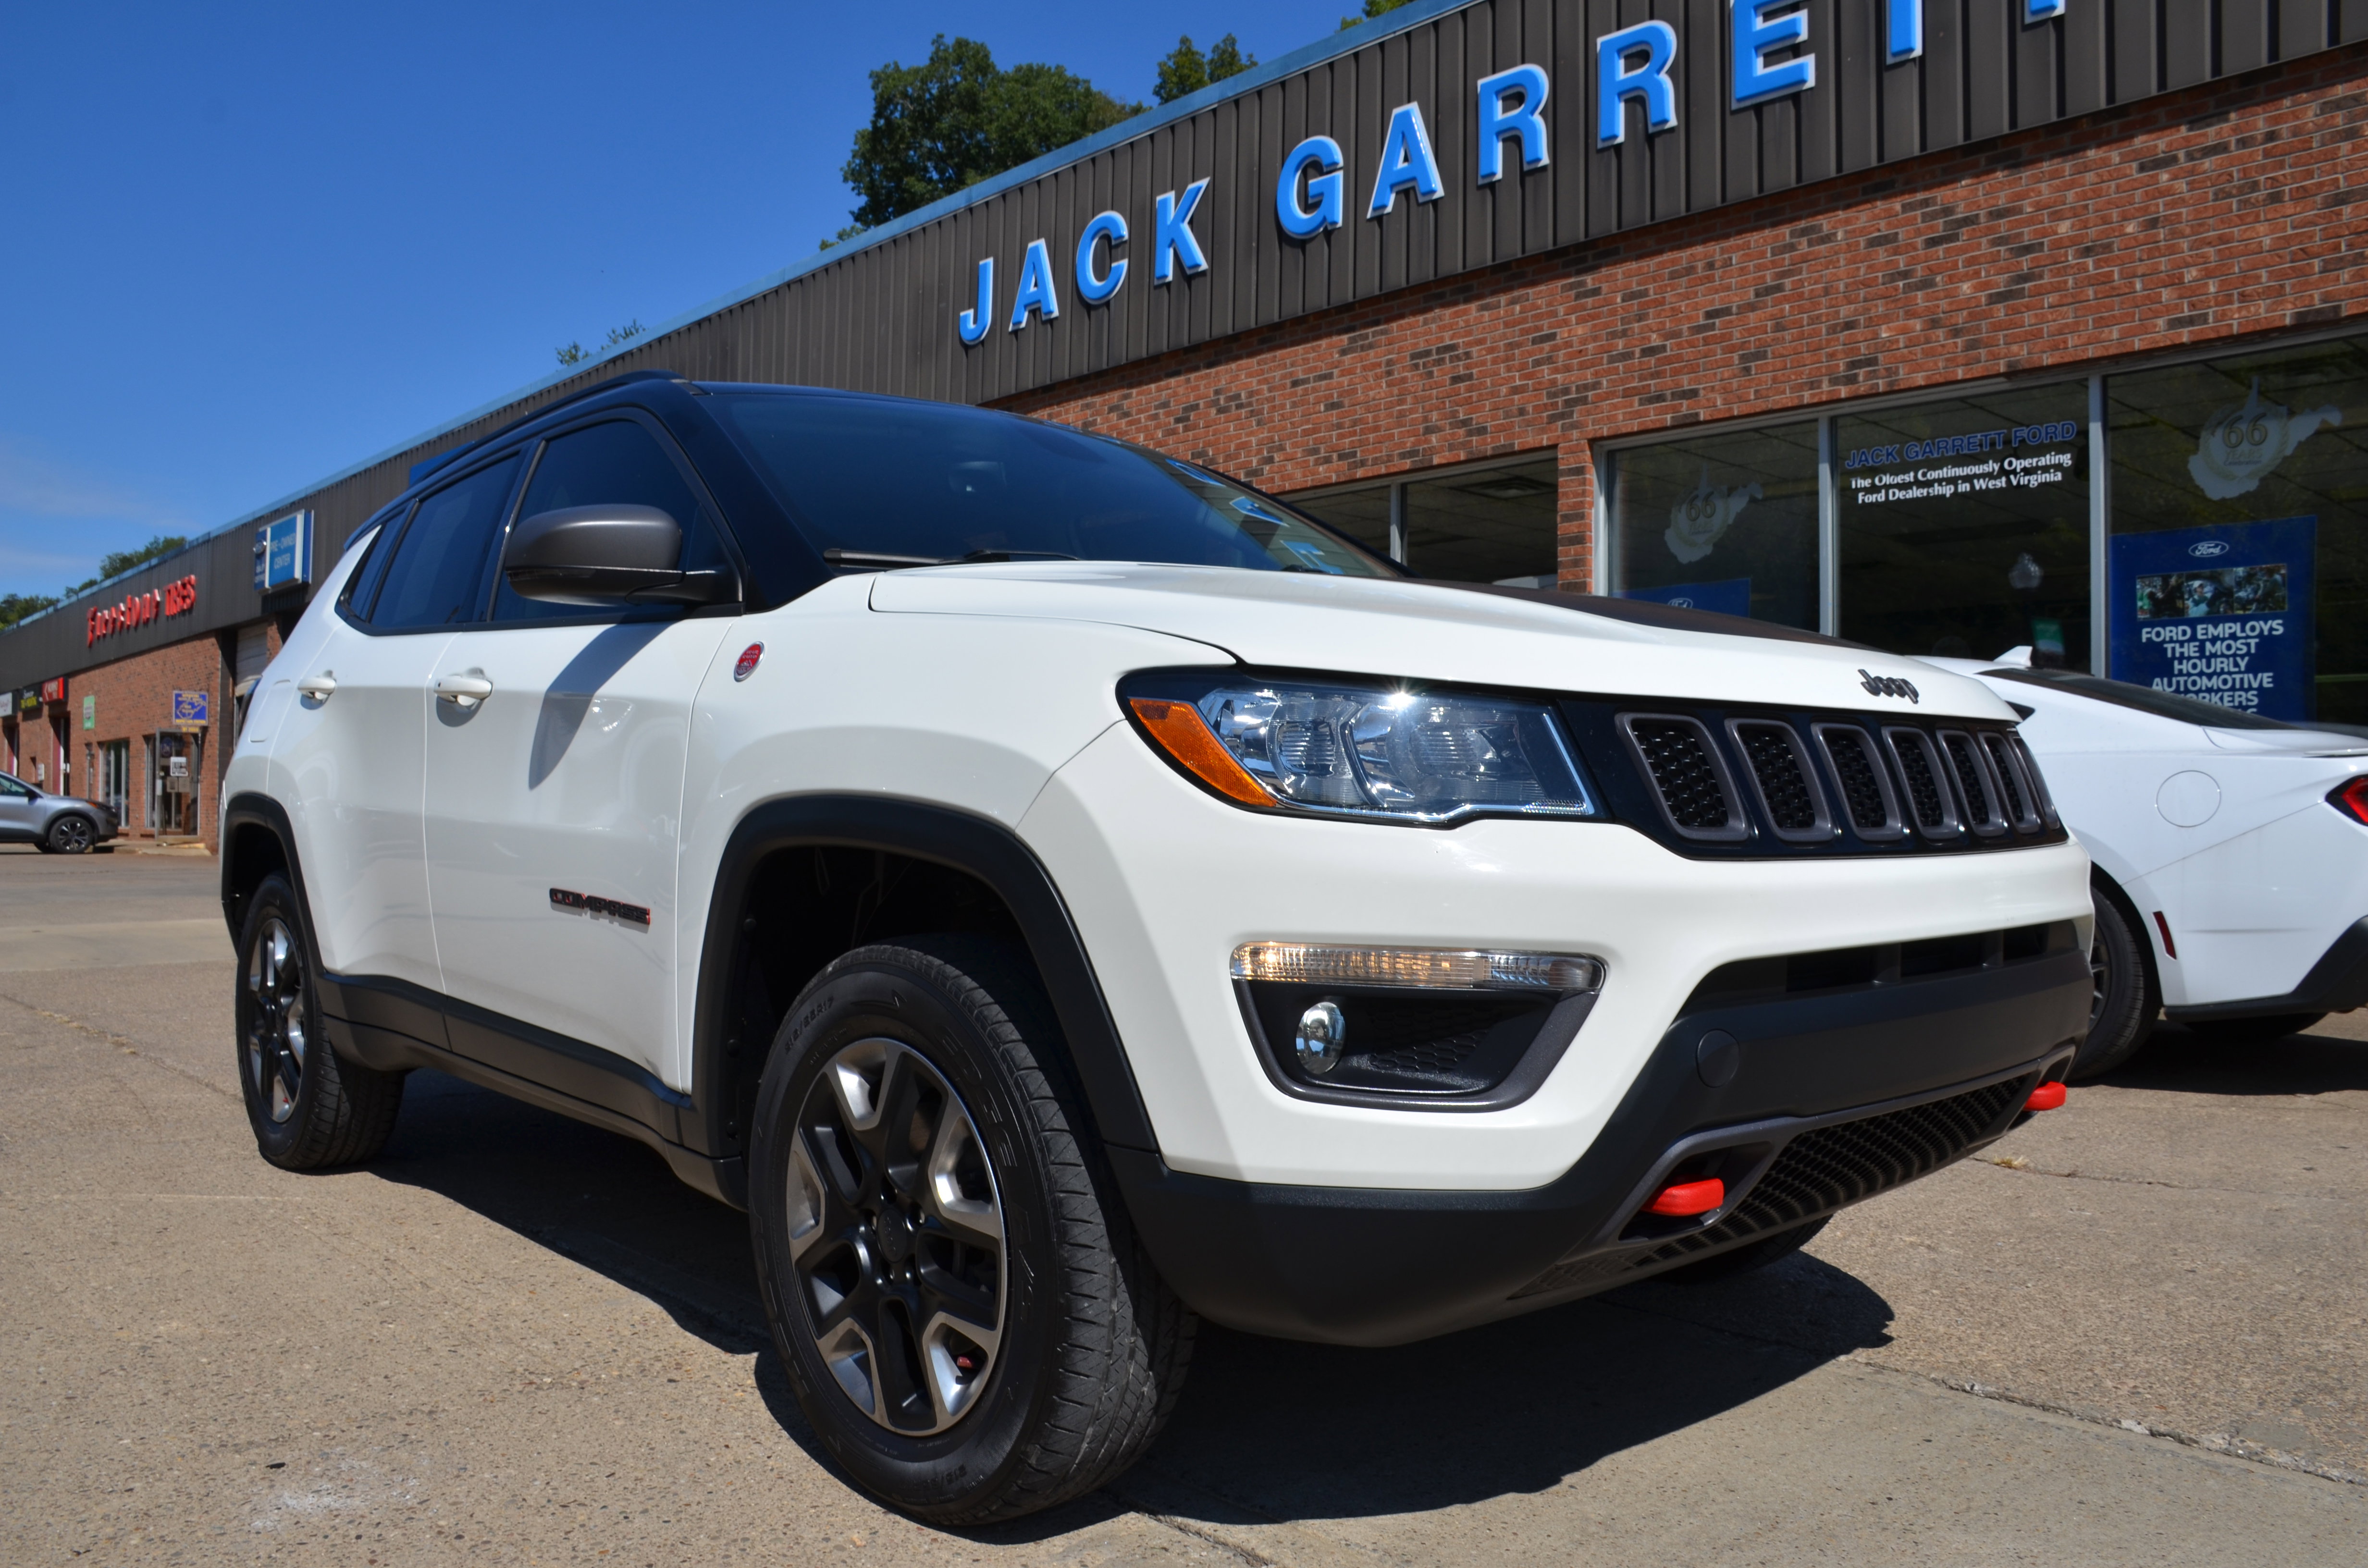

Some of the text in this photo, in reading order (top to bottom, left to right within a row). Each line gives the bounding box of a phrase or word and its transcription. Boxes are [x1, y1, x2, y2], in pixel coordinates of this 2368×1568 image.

[959, 0, 2065, 346] JACK GARRE
[1845, 420, 2077, 469] JACK GARRETT FORD
[2222, 412, 2268, 449] 66
[1850, 477, 1872, 489] The
[1917, 459, 2001, 481] Continuously
[2003, 451, 2072, 471] Operating
[1857, 468, 2063, 504] Ford Dealership in West Virginia
[1685, 491, 1717, 522] 66
[2195, 543, 2221, 555] Ford
[87, 588, 160, 648] Firestone
[2142, 619, 2284, 643] FORD EMPLOYS
[2163, 638, 2259, 658] THE MOST
[2173, 656, 2249, 674] HOURLY
[1857, 668, 1919, 705] Jeep
[2151, 672, 2274, 692] AUTOMOTIVE
[549, 887, 651, 925] COMPASS
